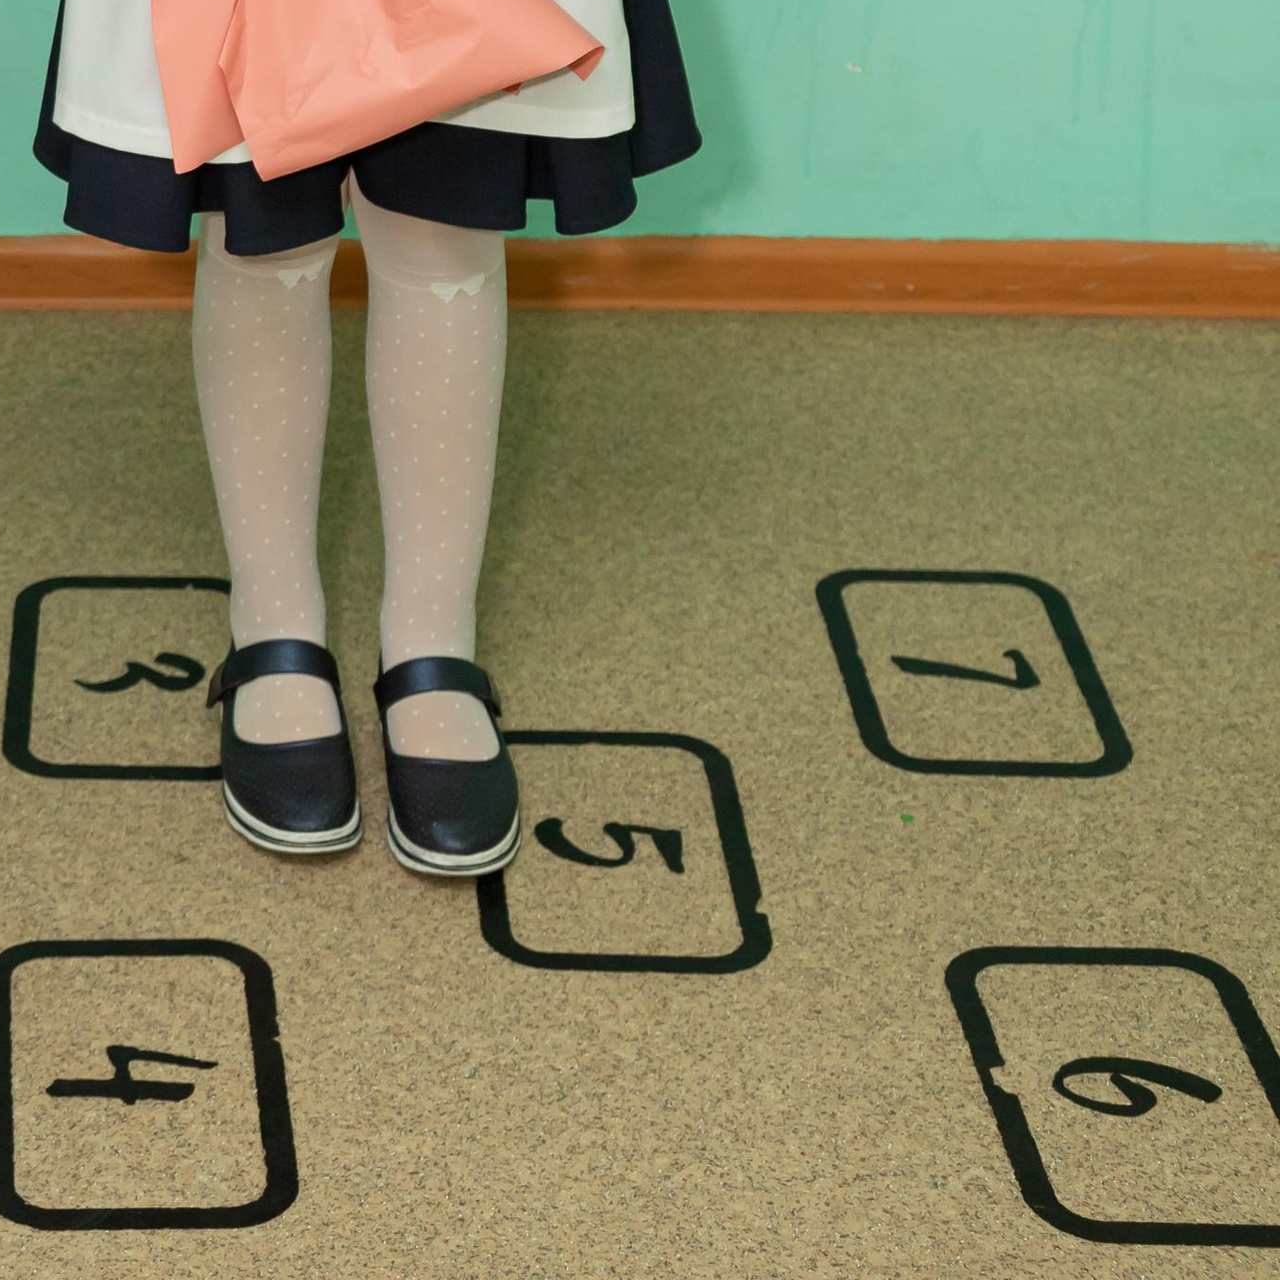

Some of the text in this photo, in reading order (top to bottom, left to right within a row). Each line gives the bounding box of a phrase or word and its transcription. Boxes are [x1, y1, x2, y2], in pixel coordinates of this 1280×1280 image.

[75, 652, 206, 693] 3
[890, 648, 1041, 690] 7
[533, 817, 685, 874] 5
[45, 1045, 218, 1105] 4
[1052, 1056, 1223, 1117] 6
